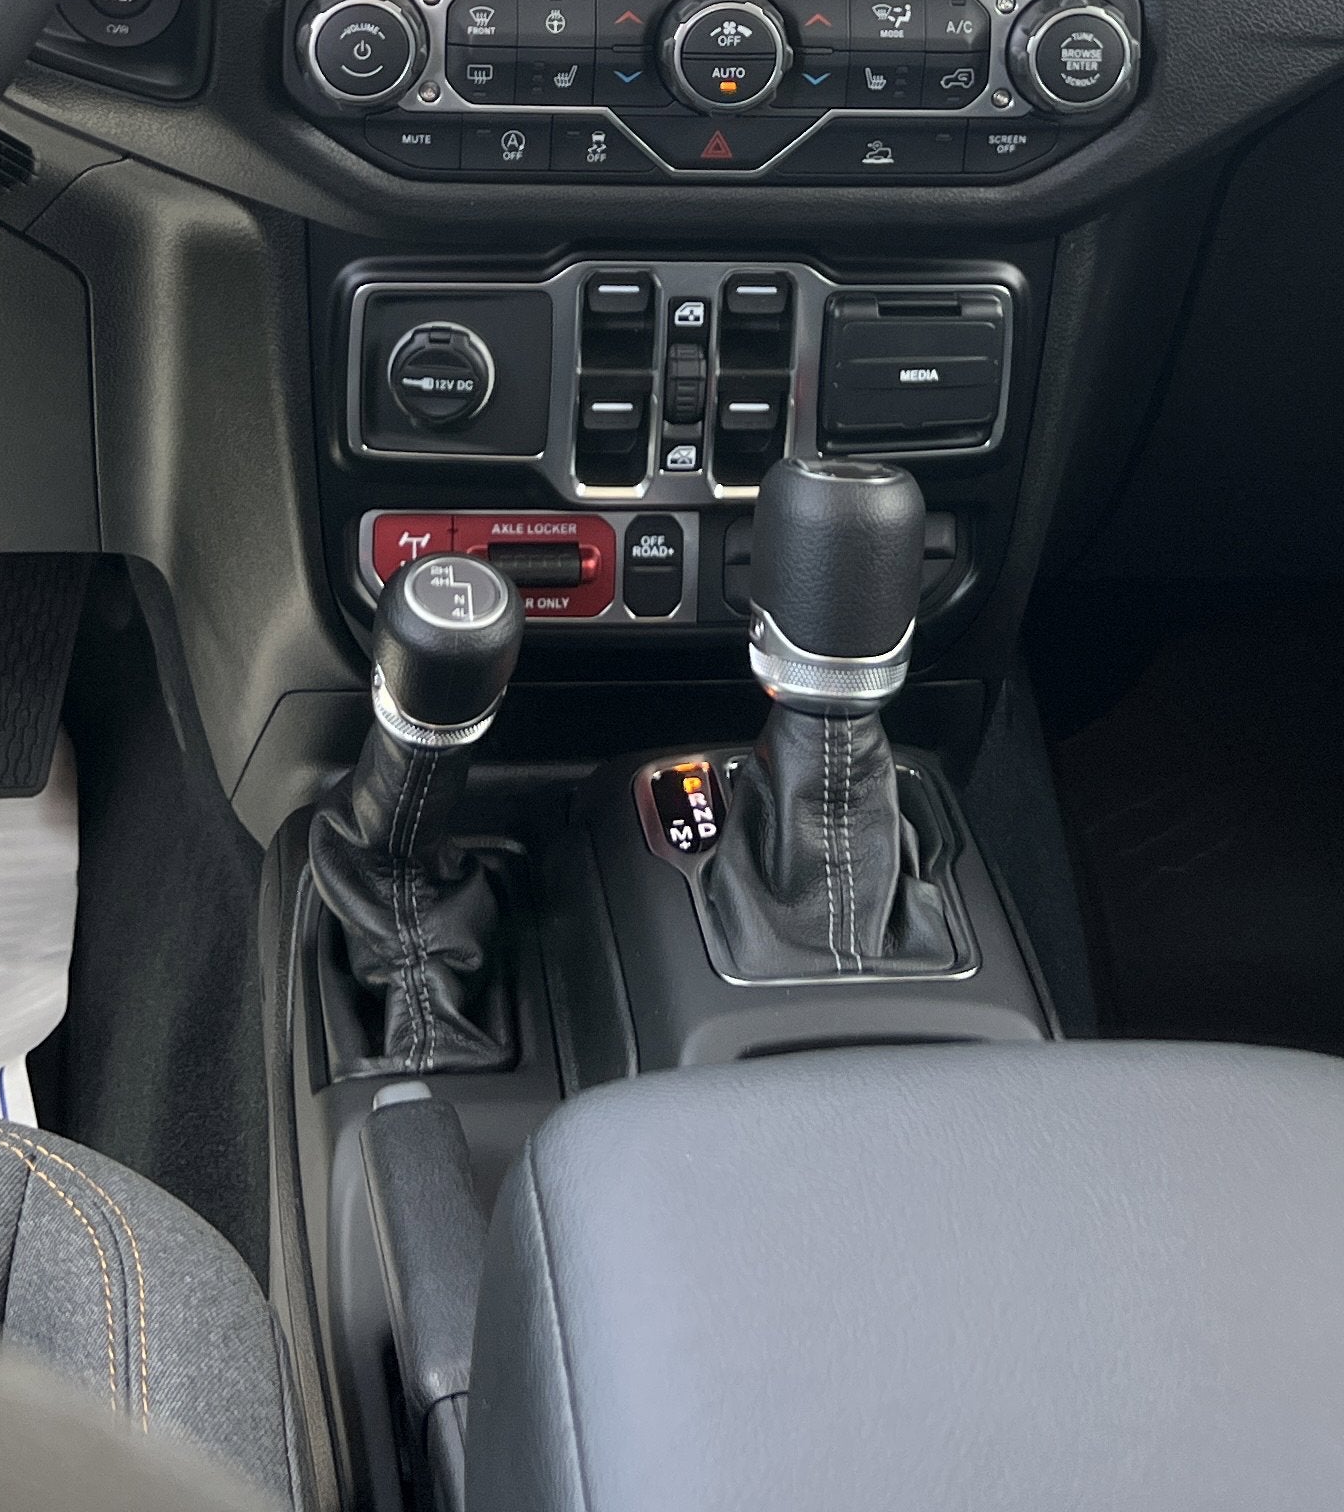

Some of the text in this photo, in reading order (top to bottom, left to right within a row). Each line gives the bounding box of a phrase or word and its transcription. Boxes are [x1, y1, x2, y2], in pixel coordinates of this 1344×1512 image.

[344, 23, 380, 35] VOLUME
[467, 27, 495, 35] FRONT
[946, 19, 973, 35] A/C
[880, 30, 904, 38] MODE
[1072, 32, 1094, 42] TUNE
[717, 34, 741, 46] OFF
[1061, 49, 1102, 58] BROWSE
[1067, 61, 1097, 71] ENTER
[712, 67, 745, 79] AUTO
[1065, 76, 1096, 87] SCROLL
[402, 135, 431, 144] MUTE
[988, 135, 1026, 144] SCREEN
[997, 144, 1015, 153] OFF
[503, 152, 522, 161] OFF
[587, 153, 606, 162] OFF
[900, 368, 939, 382] MEDIA
[434, 379, 474, 390] 12V DC
[492, 524, 577, 534] AXLE LOCKER
[640, 536, 665, 546] OFF
[632, 546, 674, 557] ROAD+
[454, 594, 465, 605] N
[537, 598, 570, 608] ONLY
[683, 777, 702, 793] P
[688, 792, 707, 807] R
[693, 807, 713, 822] N
[670, 826, 693, 841] M
[698, 823, 716, 838] D
